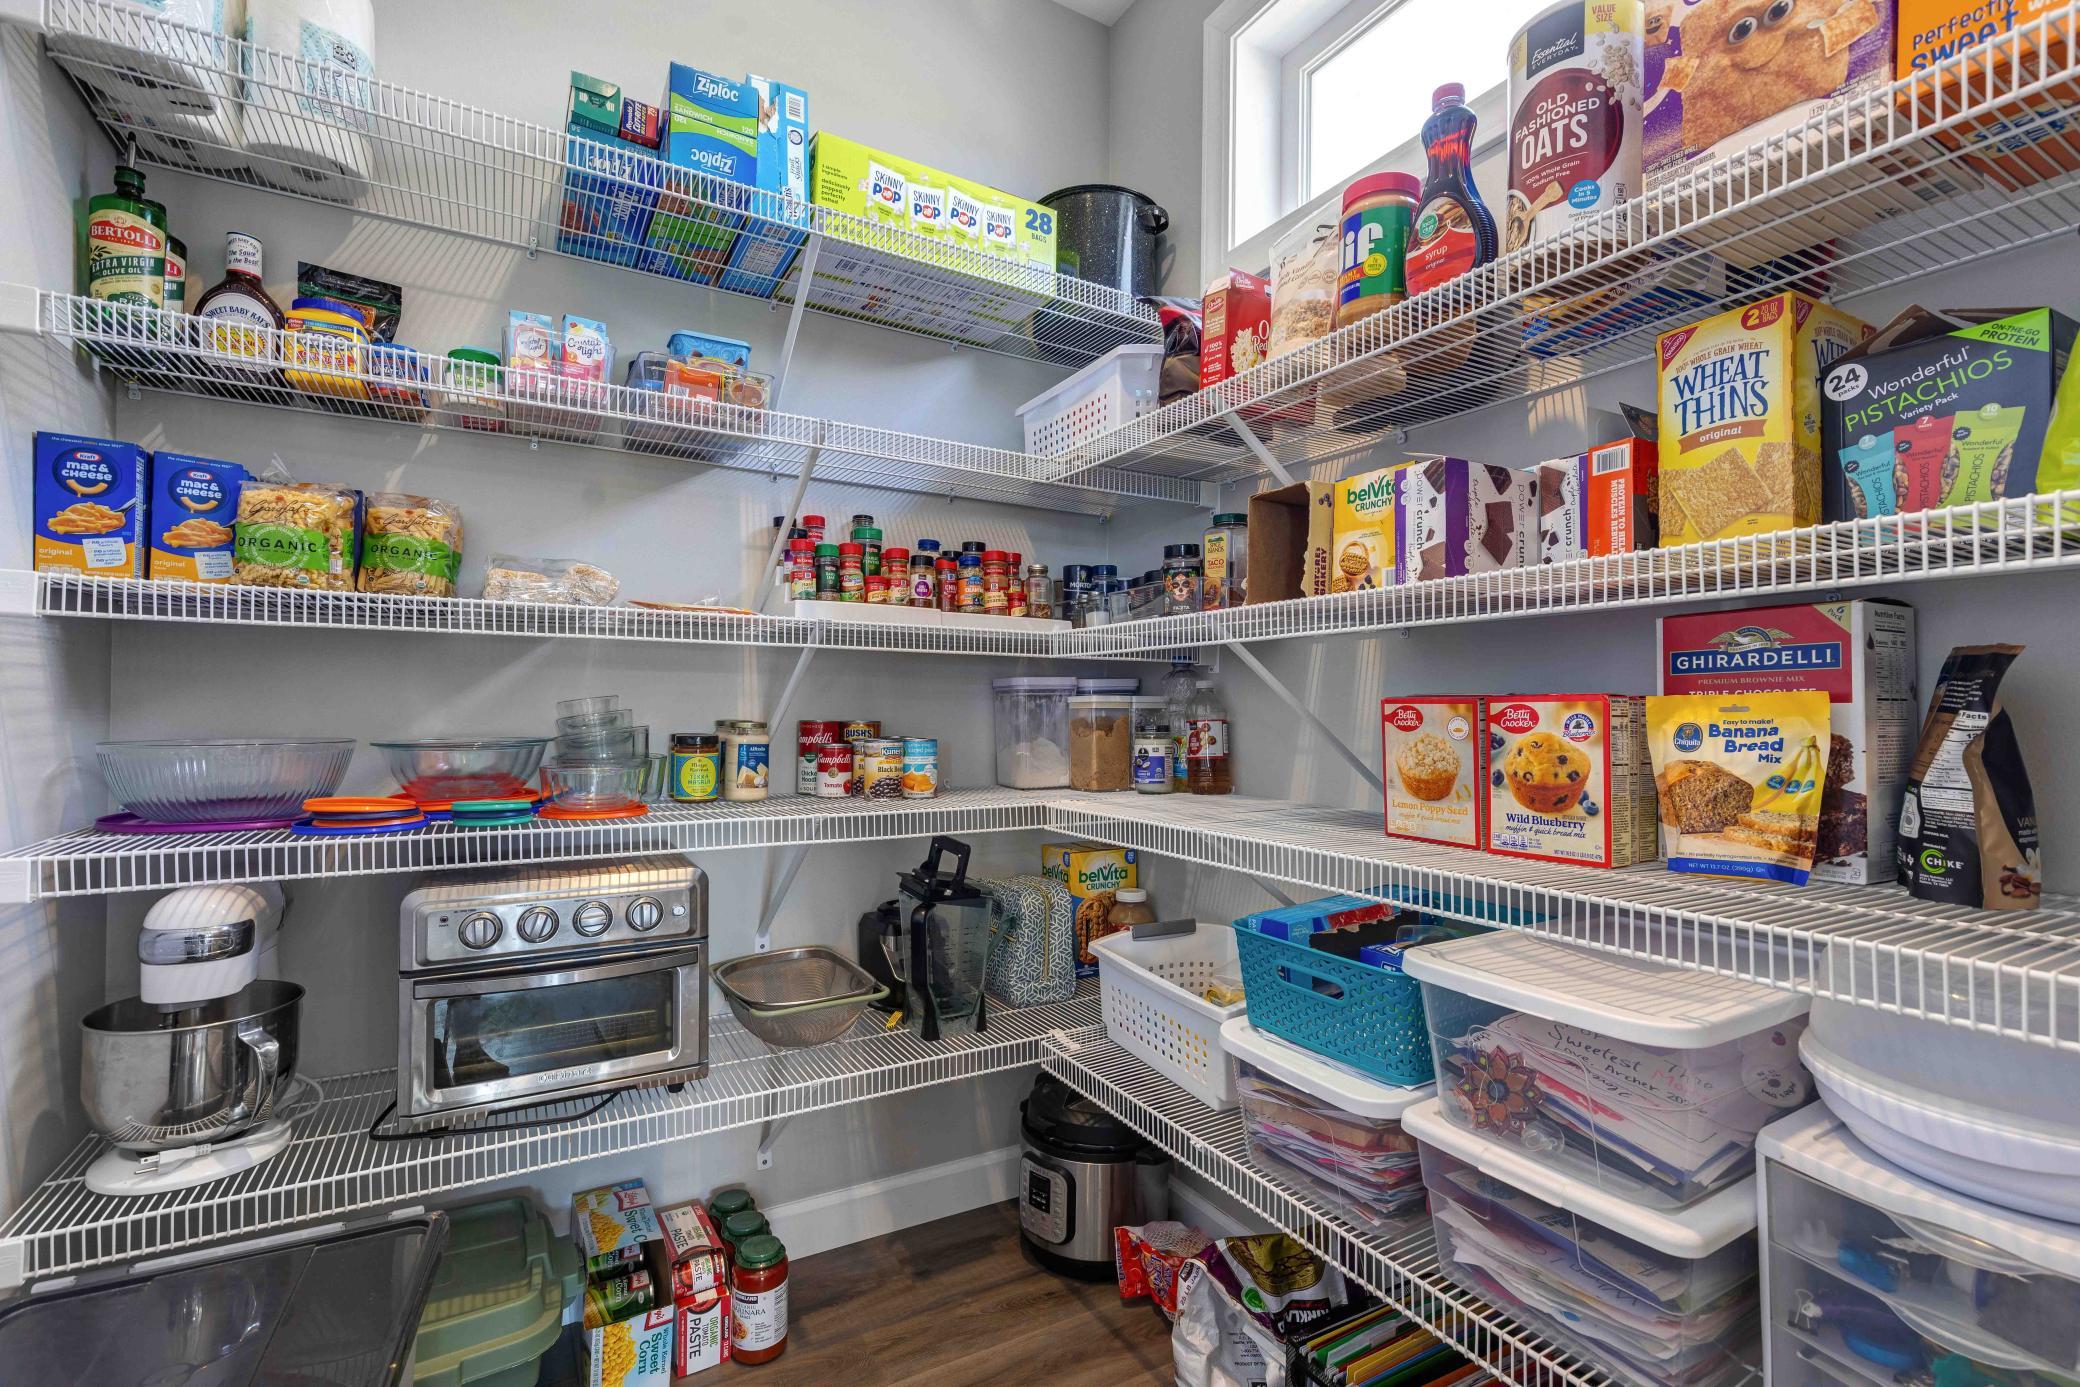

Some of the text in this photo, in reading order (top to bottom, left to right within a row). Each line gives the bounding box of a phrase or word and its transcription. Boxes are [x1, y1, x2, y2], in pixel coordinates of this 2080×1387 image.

[1592, 3, 1616, 14] VALUE
[1596, 13, 1613, 22] SIZE
[1532, 32, 1577, 65] Essential
[1532, 46, 1576, 69] EVERYDAY
[697, 75, 739, 102] Ziploc
[1536, 93, 1568, 115] OLD
[674, 104, 713, 122] SANDWICH
[1515, 97, 1600, 143] FASHIONED
[1522, 114, 1588, 169] OATS
[690, 149, 734, 174] Ziploc
[1525, 160, 1580, 184] 100% Whole Grain
[1532, 170, 1571, 188] Sodium Free
[875, 171, 903, 191] SKINNY
[1574, 185, 1594, 193] Cooks
[873, 183, 901, 203] POP
[913, 190, 941, 206] SKINNY
[1572, 195, 1597, 203] Minutes
[914, 203, 941, 219] POP
[953, 196, 979, 215] SKINNY
[950, 207, 977, 227] POP
[986, 210, 1011, 226] SKINNY
[1025, 209, 1053, 235] 28
[91, 225, 158, 249] BERTOLLI
[987, 223, 1012, 239] POP
[1032, 233, 1047, 244] BAGS
[1425, 245, 1448, 260] syrup
[92, 257, 154, 272] EXTRA VIRGIN
[205, 305, 271, 329] SWEET BABY RAY'S
[1748, 309, 1760, 326] 2
[1762, 312, 1778, 323] BAGS
[1980, 329, 2040, 346] PROTEIN
[1992, 323, 2040, 336] ON-THE-GO
[1690, 351, 1712, 366] WHOLE
[1714, 343, 1735, 358] GRAIN
[1738, 341, 1764, 351] WHEAT
[1670, 350, 1770, 400] WHEAT
[1829, 368, 1860, 393] 24
[1868, 348, 1963, 399] Wonderful
[1838, 383, 1860, 397] packs
[1845, 350, 2013, 432] PISTACHIOS
[1900, 393, 1959, 420] Variety Pack
[1700, 425, 1742, 443] original
[80, 452, 96, 460] Kraft
[67, 461, 109, 473] mac &
[193, 472, 208, 480] Kraft
[1965, 453, 1985, 502] PISTACHIOS
[181, 479, 219, 491] mac &
[1355, 496, 1393, 512] CRUNCHY
[1416, 509, 1425, 550] crunch
[1563, 508, 1572, 546] crunch
[1618, 517, 1625, 529] TO
[39, 547, 72, 555] original
[238, 537, 317, 553] ORGANIC
[370, 544, 438, 560] ORGANIC
[1320, 548, 1328, 595] BAKERY
[1827, 607, 1843, 622] Pack
[1837, 606, 1845, 614] 6
[1676, 648, 1832, 670] GHIRARDELLI
[1739, 676, 1784, 685] BROWNIE
[1394, 718, 1421, 727] Crocker
[1396, 709, 1417, 721] Betty
[1501, 718, 1534, 728] Crocker
[1506, 709, 1530, 721] Betty
[845, 729, 872, 738] BUSH'S
[1708, 724, 1779, 738] Banana
[1674, 738, 1701, 746] Chiquita
[1724, 738, 1784, 753] Bread
[1758, 753, 1781, 764] Mix
[1392, 800, 1468, 816] Lemon Poppy Seed
[1506, 813, 1585, 831] Wild Blueberry
[1506, 825, 1527, 834] muffin
[1533, 829, 1551, 838] quick
[1552, 829, 1572, 837] bread
[1926, 856, 1962, 869] CHIKE
[1078, 862, 1128, 883] belVita
[1086, 881, 1121, 891] CRUNCHY
[1548, 1023, 1642, 1072] Sweetest
[625, 1209, 641, 1234] Sweet
[673, 1228, 689, 1249] PASTE
[693, 1260, 703, 1282] PASTE
[1180, 1285, 1192, 1306] 25 LB
[689, 1317, 702, 1360] PASTE
[709, 1316, 718, 1348] ORGANIC
[638, 1340, 650, 1375] Corn
[650, 1332, 662, 1374] Sweet
[661, 1327, 670, 1374] Whole Kernel
